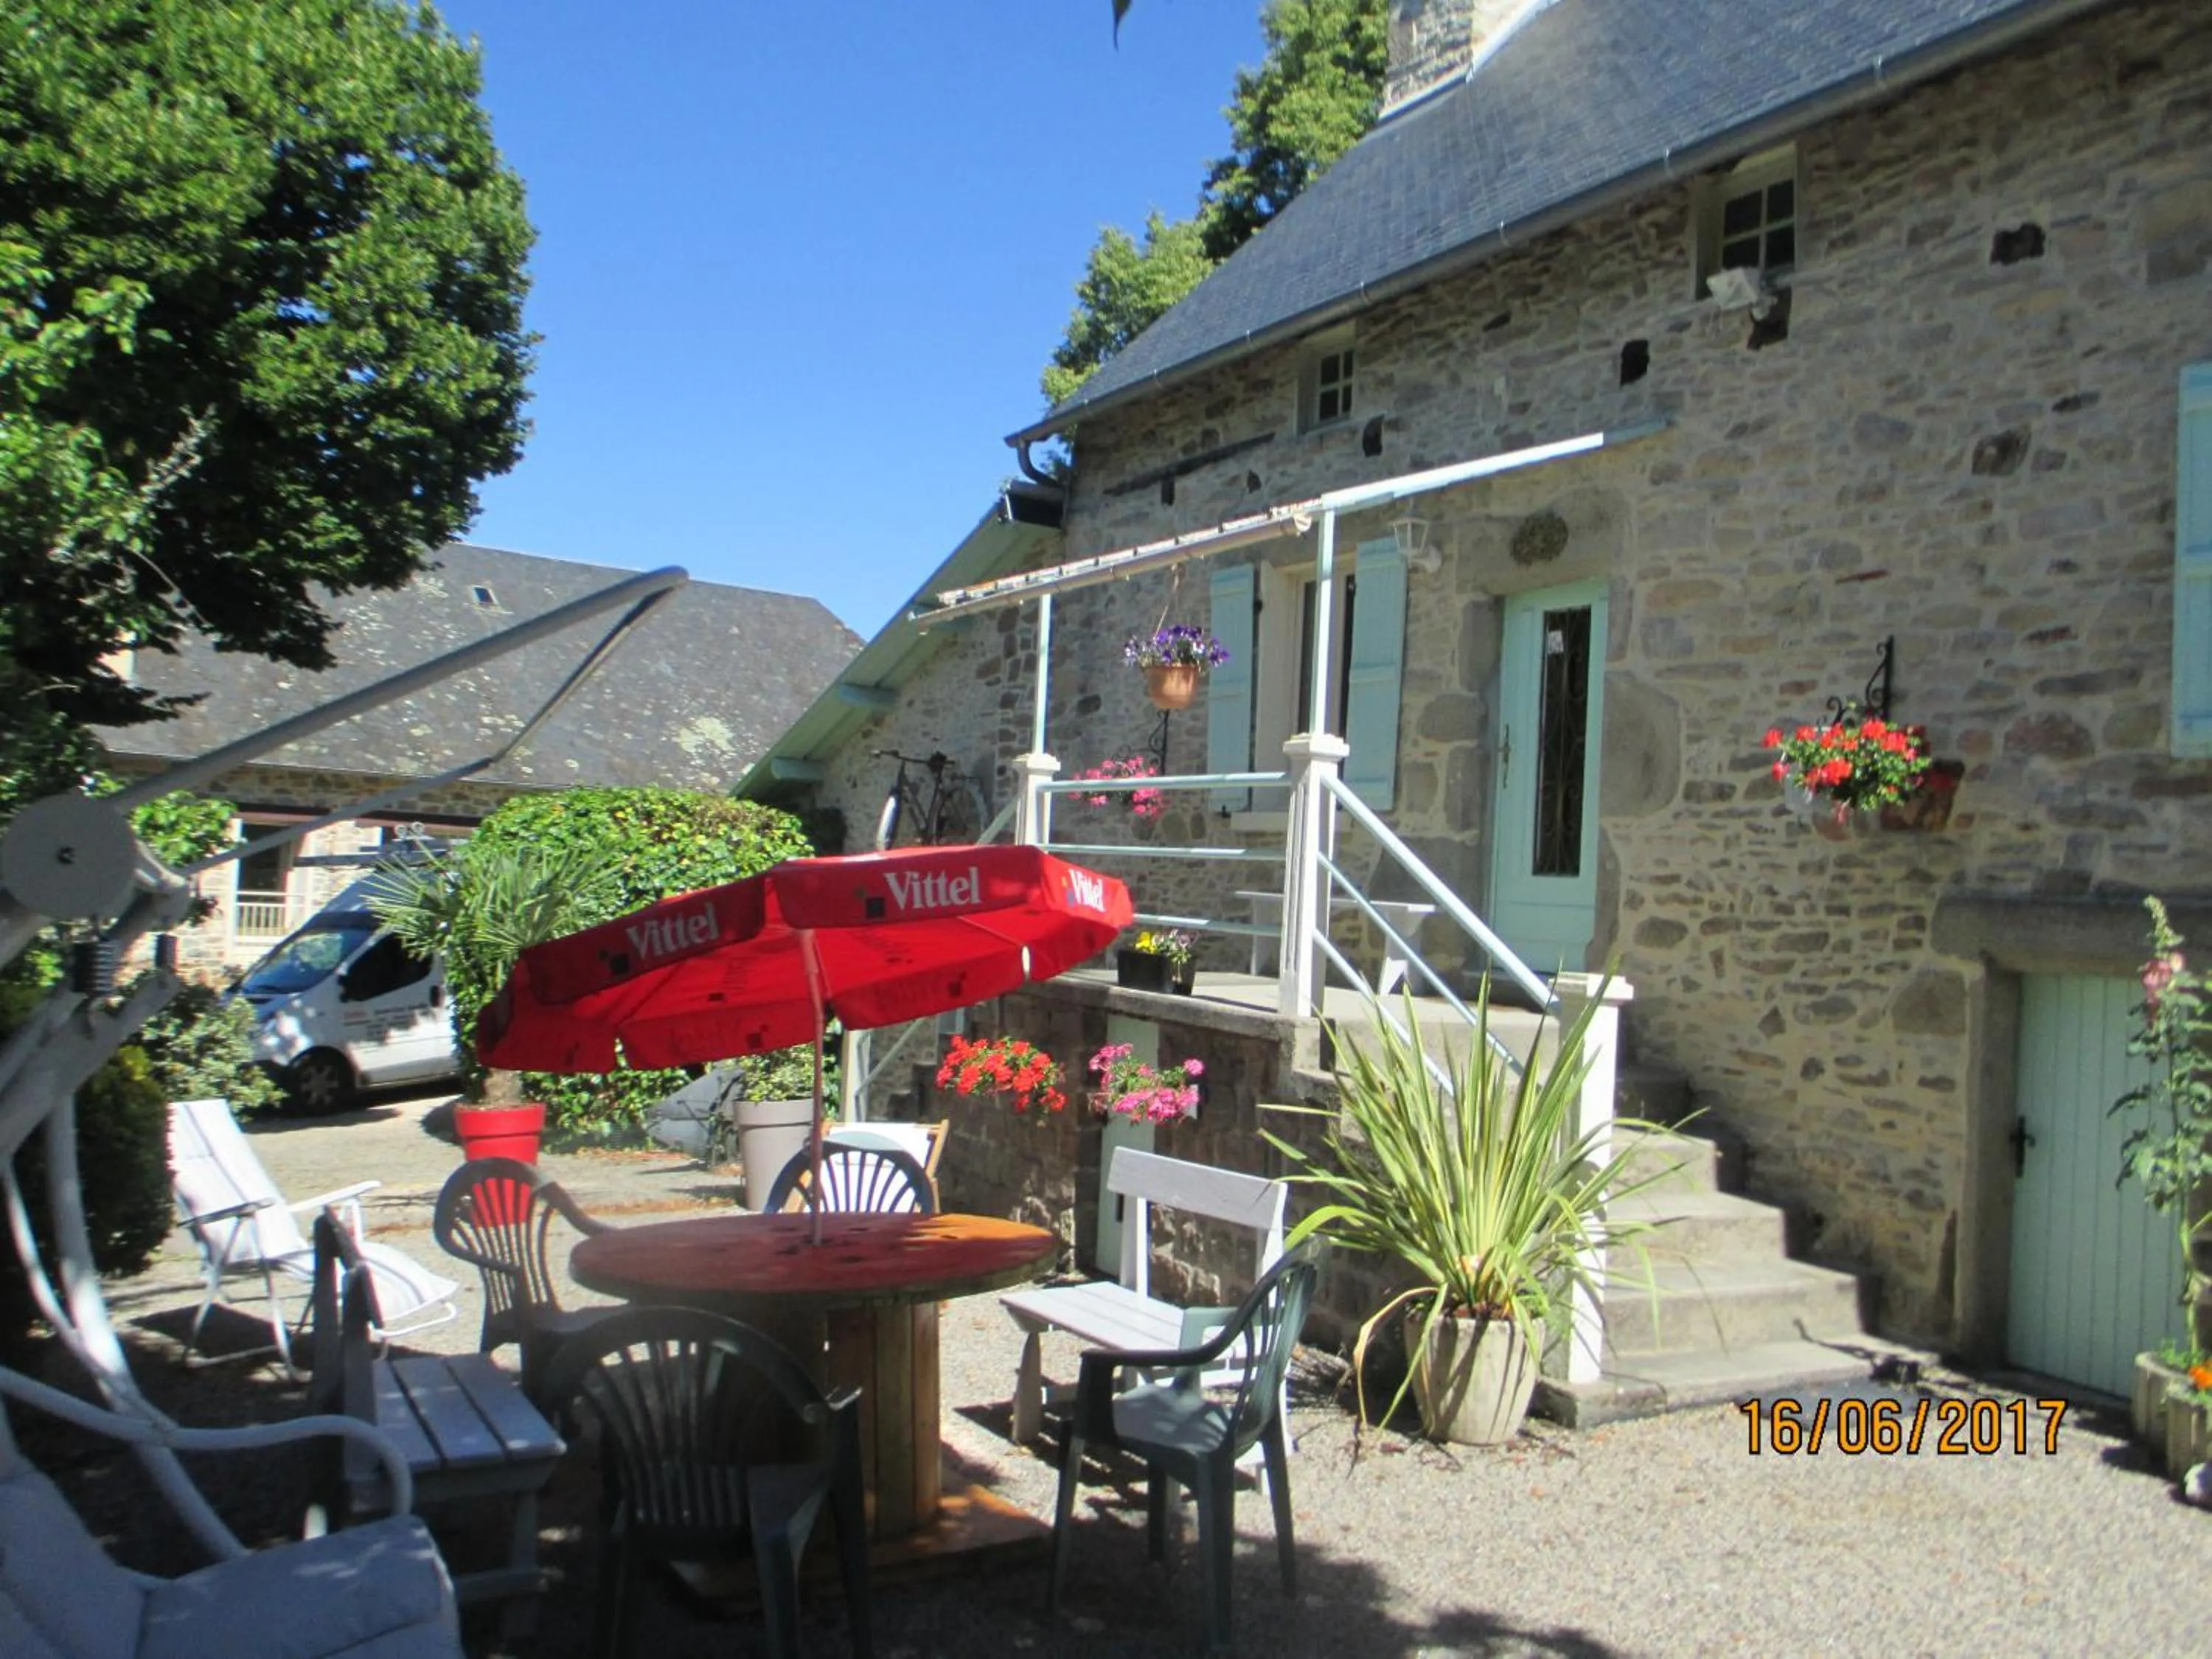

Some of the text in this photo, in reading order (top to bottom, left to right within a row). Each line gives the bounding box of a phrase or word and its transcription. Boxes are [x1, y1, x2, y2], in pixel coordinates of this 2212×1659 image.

[883, 866, 981, 910] Vittel
[1068, 869, 1106, 913] Vittel
[626, 901, 720, 959] Vittel
